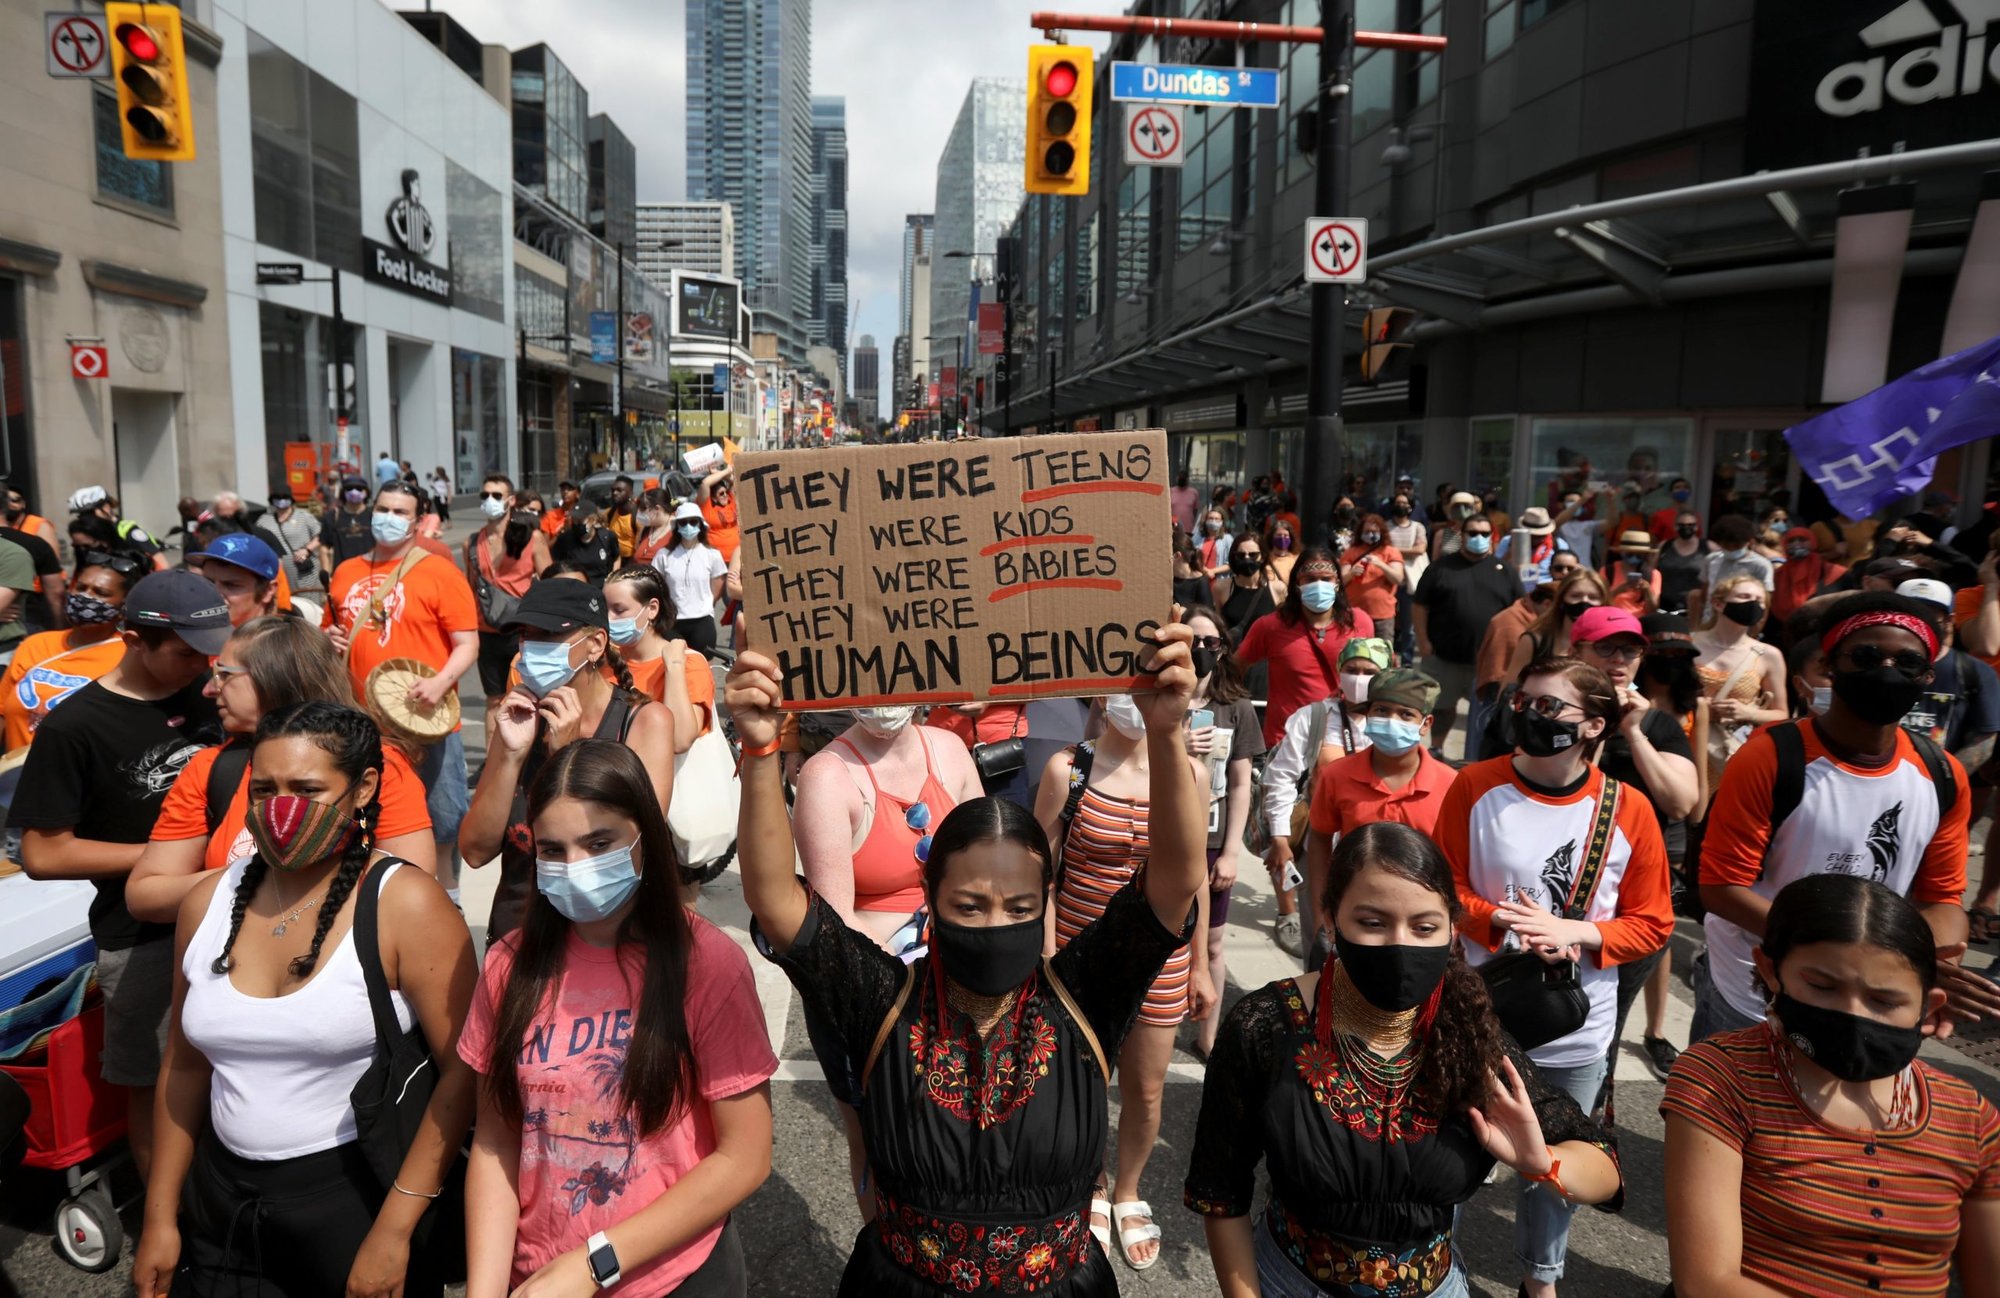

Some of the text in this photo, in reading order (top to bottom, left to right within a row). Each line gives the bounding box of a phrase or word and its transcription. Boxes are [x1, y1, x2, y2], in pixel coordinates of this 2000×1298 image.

[1143, 67, 1251, 96] Dundas St
[1815, 24, 2000, 117] adi
[376, 249, 449, 297] Foot Locker
[739, 443, 1152, 515] THEY WERE TEENS
[744, 505, 1074, 561] THEY WERE KIDS
[753, 544, 1117, 605] THEY WERE BABIES
[759, 596, 979, 644] THEY WERE
[777, 620, 1175, 701] HUMAN BEINGS
[1826, 852, 1868, 863] EVERY
[566, 1008, 632, 1057] DIE
